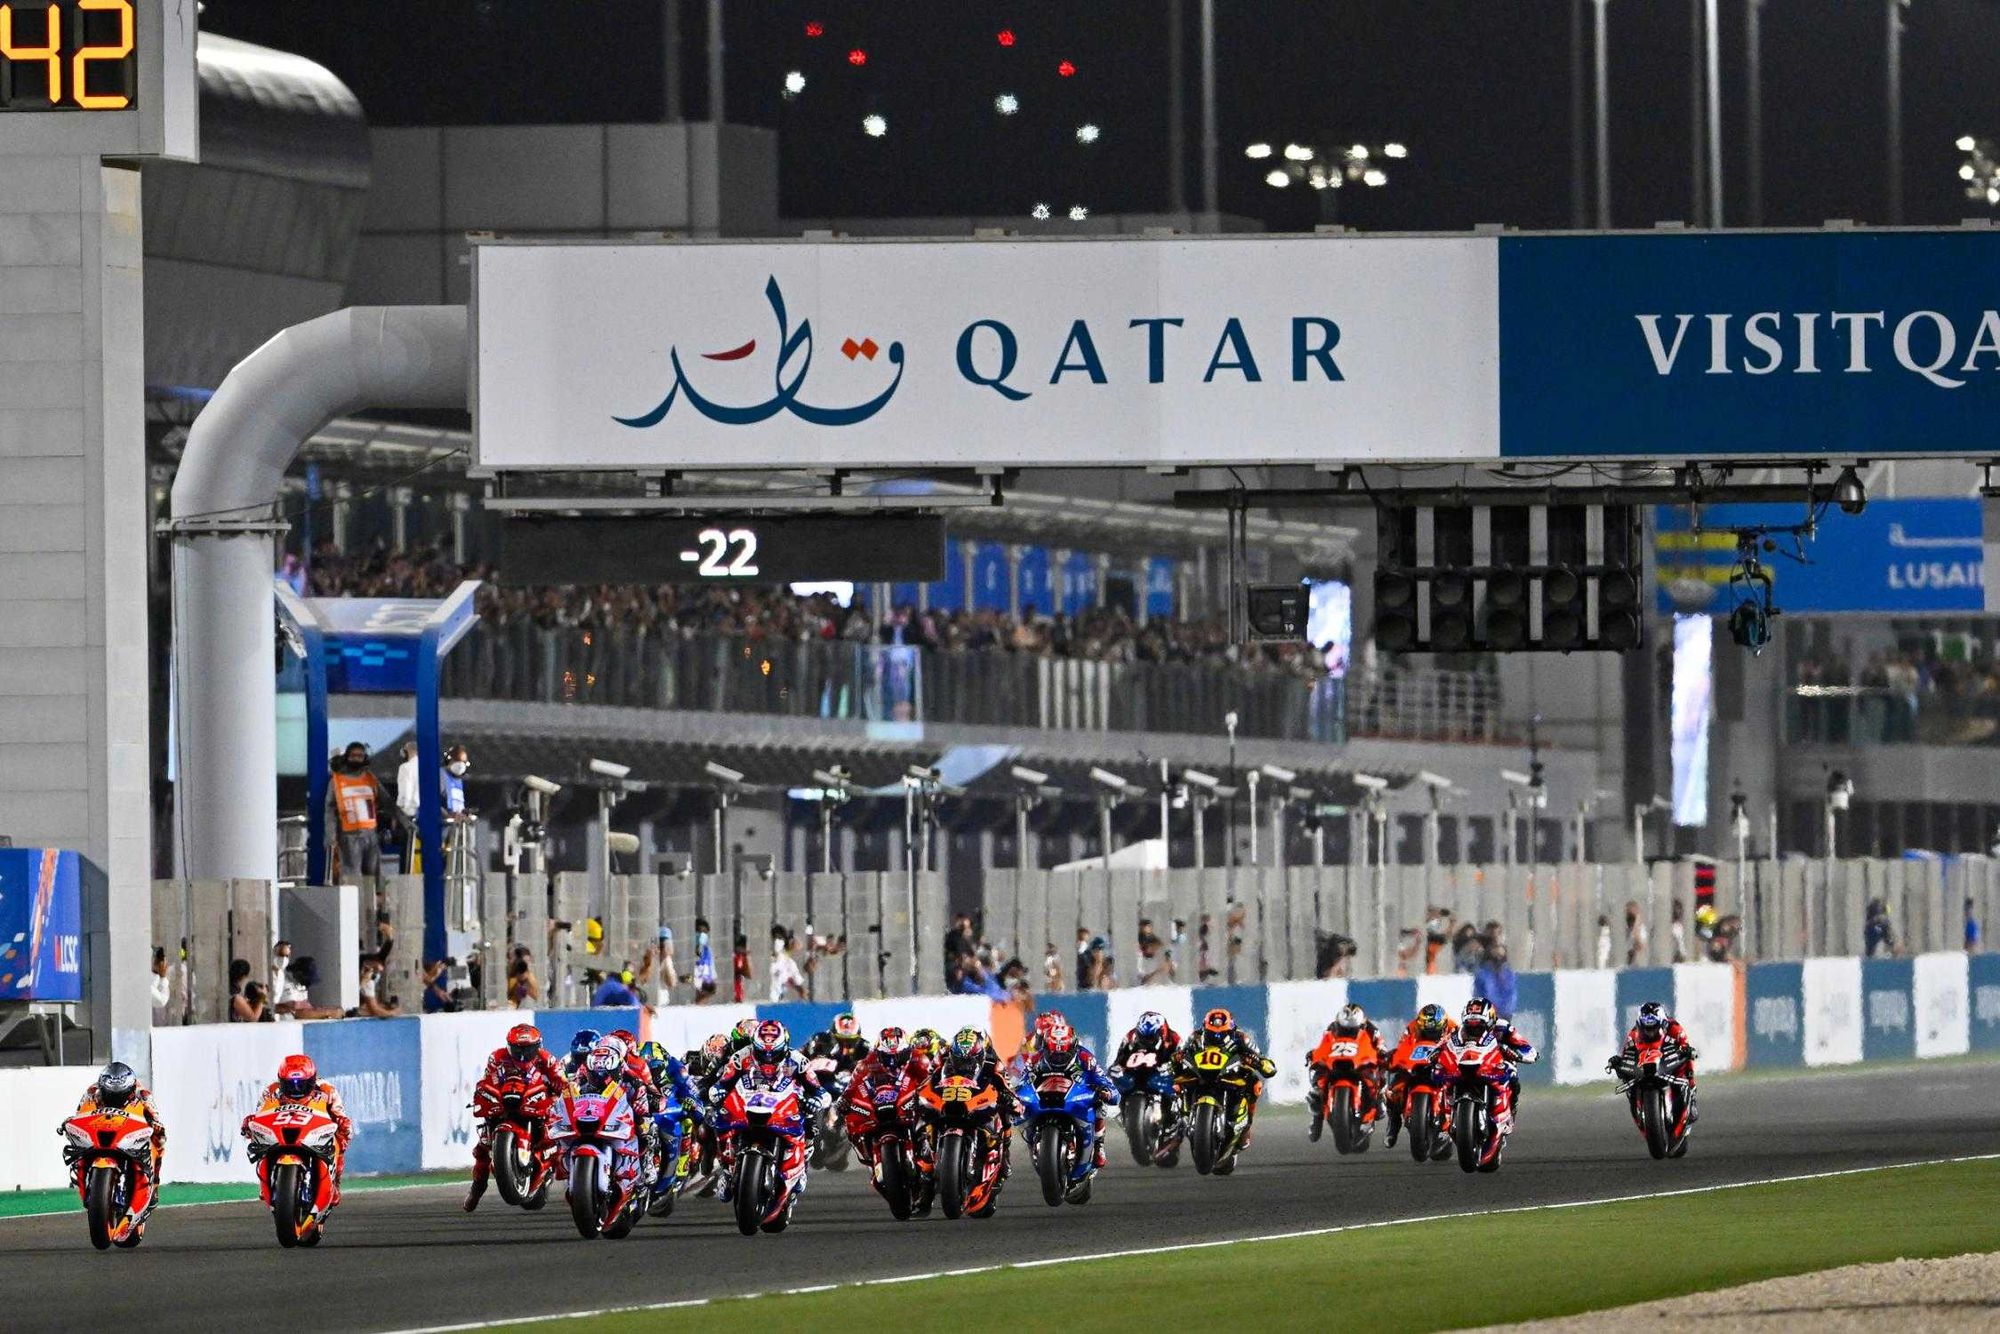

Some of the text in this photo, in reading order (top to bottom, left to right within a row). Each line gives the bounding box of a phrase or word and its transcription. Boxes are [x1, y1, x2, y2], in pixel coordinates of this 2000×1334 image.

[0, 0, 133, 108] 42
[1636, 311, 2000, 388] VISITQA
[956, 317, 1345, 401] QATAR
[679, 529, 759, 576] -22
[1329, 1042, 1358, 1056] 25
[1126, 1052, 1157, 1067] 04
[1201, 1052, 1222, 1066] 10
[943, 1087, 972, 1101] 33
[274, 1104, 314, 1113] REPSOL
